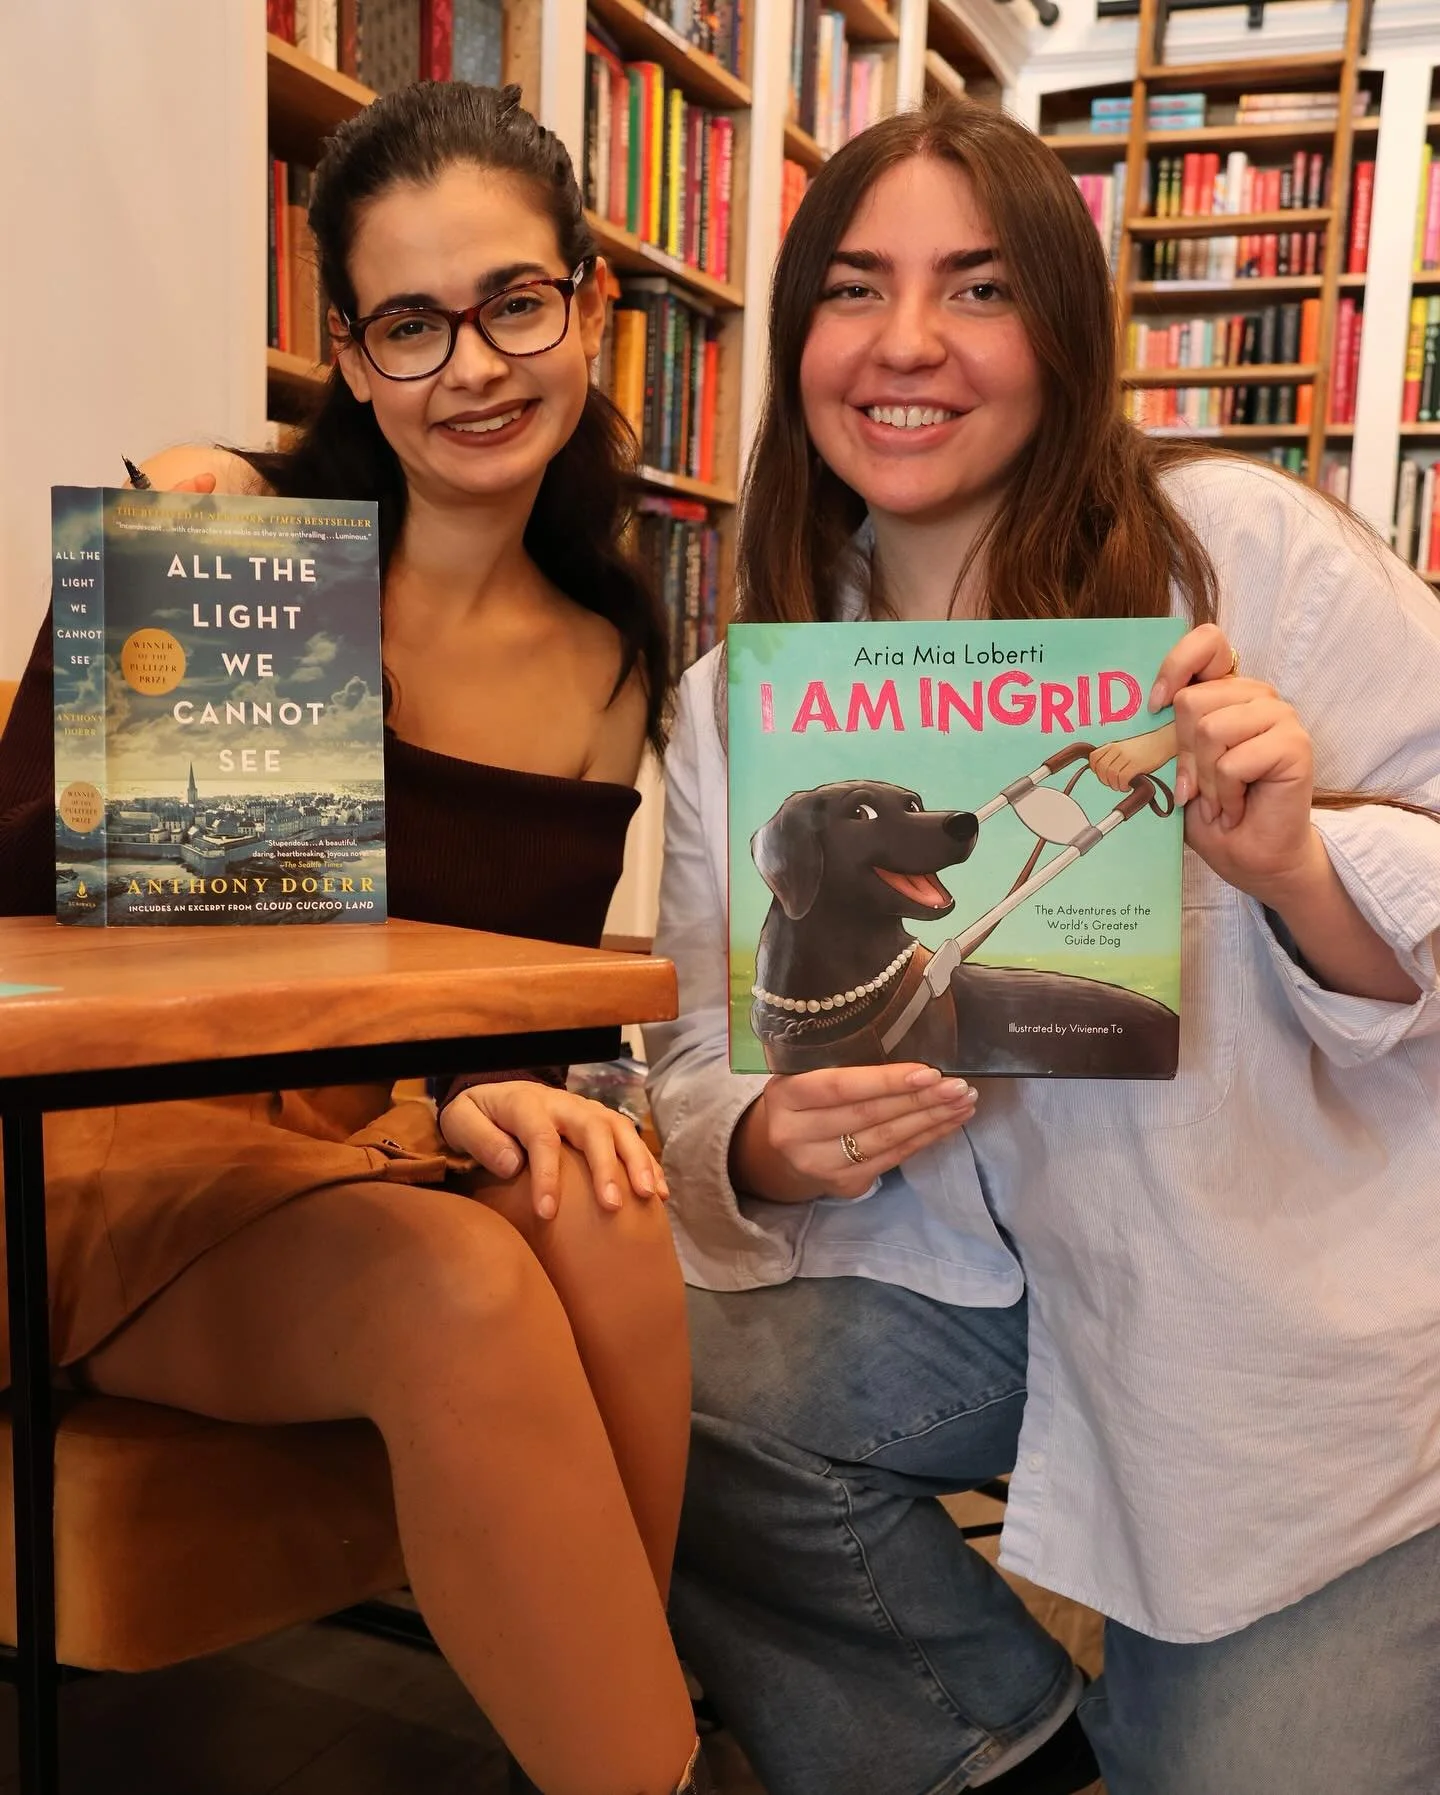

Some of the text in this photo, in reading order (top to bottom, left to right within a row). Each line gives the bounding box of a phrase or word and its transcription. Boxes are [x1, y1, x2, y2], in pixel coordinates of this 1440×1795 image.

[304, 516, 371, 528] BESTSELLER
[55, 550, 100, 561] ALL THE
[166, 553, 317, 583] ALL THE
[61, 577, 95, 588] LIGHT
[70, 603, 87, 614] WE
[192, 603, 301, 630] LIGHT
[56, 629, 103, 640] CANNOT
[70, 655, 90, 665] SEE
[854, 642, 1044, 667] Aria Mia Loberti
[221, 652, 274, 677] WE
[760, 670, 1142, 734] I AM INGRID
[56, 713, 103, 723] ANTHONY
[173, 700, 324, 726] CANNOT
[64, 727, 96, 737] DOERR
[218, 749, 281, 773] SEE
[252, 851, 276, 859] daring,
[277, 851, 326, 859] heartbreaking,
[127, 876, 376, 896] ANTHONY DOERR
[129, 904, 172, 912] INCLUDES
[174, 904, 186, 912] AN
[188, 904, 226, 912] EXCERPT
[255, 902, 293, 911] CLOUD
[296, 901, 343, 910] CUCKOO
[345, 901, 374, 910] LAND
[1035, 904, 1151, 916] The Adventures of the
[1047, 919, 1138, 930] World's Greatest
[1064, 934, 1121, 948] Guide Dog
[1008, 1022, 1123, 1035] Illustrated by Vivienne To
